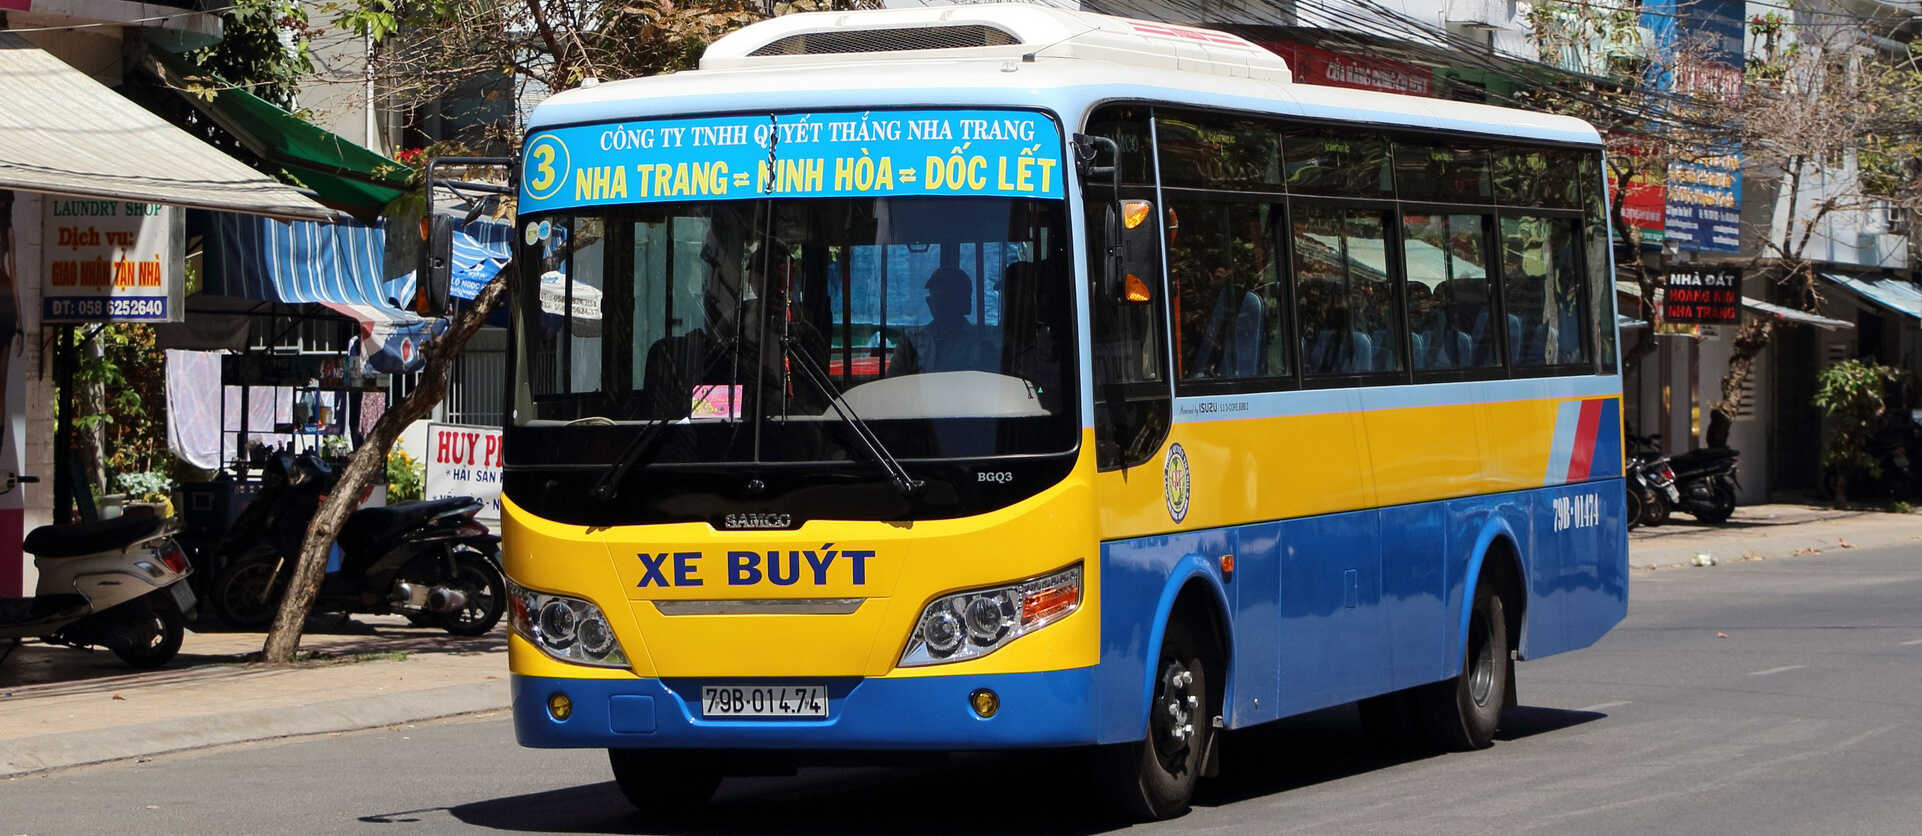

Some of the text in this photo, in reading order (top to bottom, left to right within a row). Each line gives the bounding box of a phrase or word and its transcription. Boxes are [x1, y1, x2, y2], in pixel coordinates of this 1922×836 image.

[600, 124, 655, 151] CÔNG
[660, 128, 688, 148] TY
[691, 125, 748, 146] TNHH
[828, 112, 901, 142] THẮNG
[906, 119, 952, 141] NHA
[960, 119, 1035, 141] TRANG
[531, 143, 556, 191] 3
[575, 142, 1057, 201] NHA TRANG NINH HÒA DỐC LẾT
[53, 200, 162, 216] LAUNDRY SHOP
[58, 226, 135, 252] Dịch vụ:
[113, 254, 135, 292] TẬN
[138, 253, 161, 287] NHÀ
[1669, 271, 1702, 286] NHÀ
[80, 300, 103, 316] 058
[106, 300, 163, 316] 6252640
[1199, 402, 1217, 413] ISUZU
[437, 431, 480, 466] HUY
[977, 472, 1013, 484] BGQ3
[724, 513, 791, 528] SAMCO
[637, 543, 875, 587] XE BUÝT
